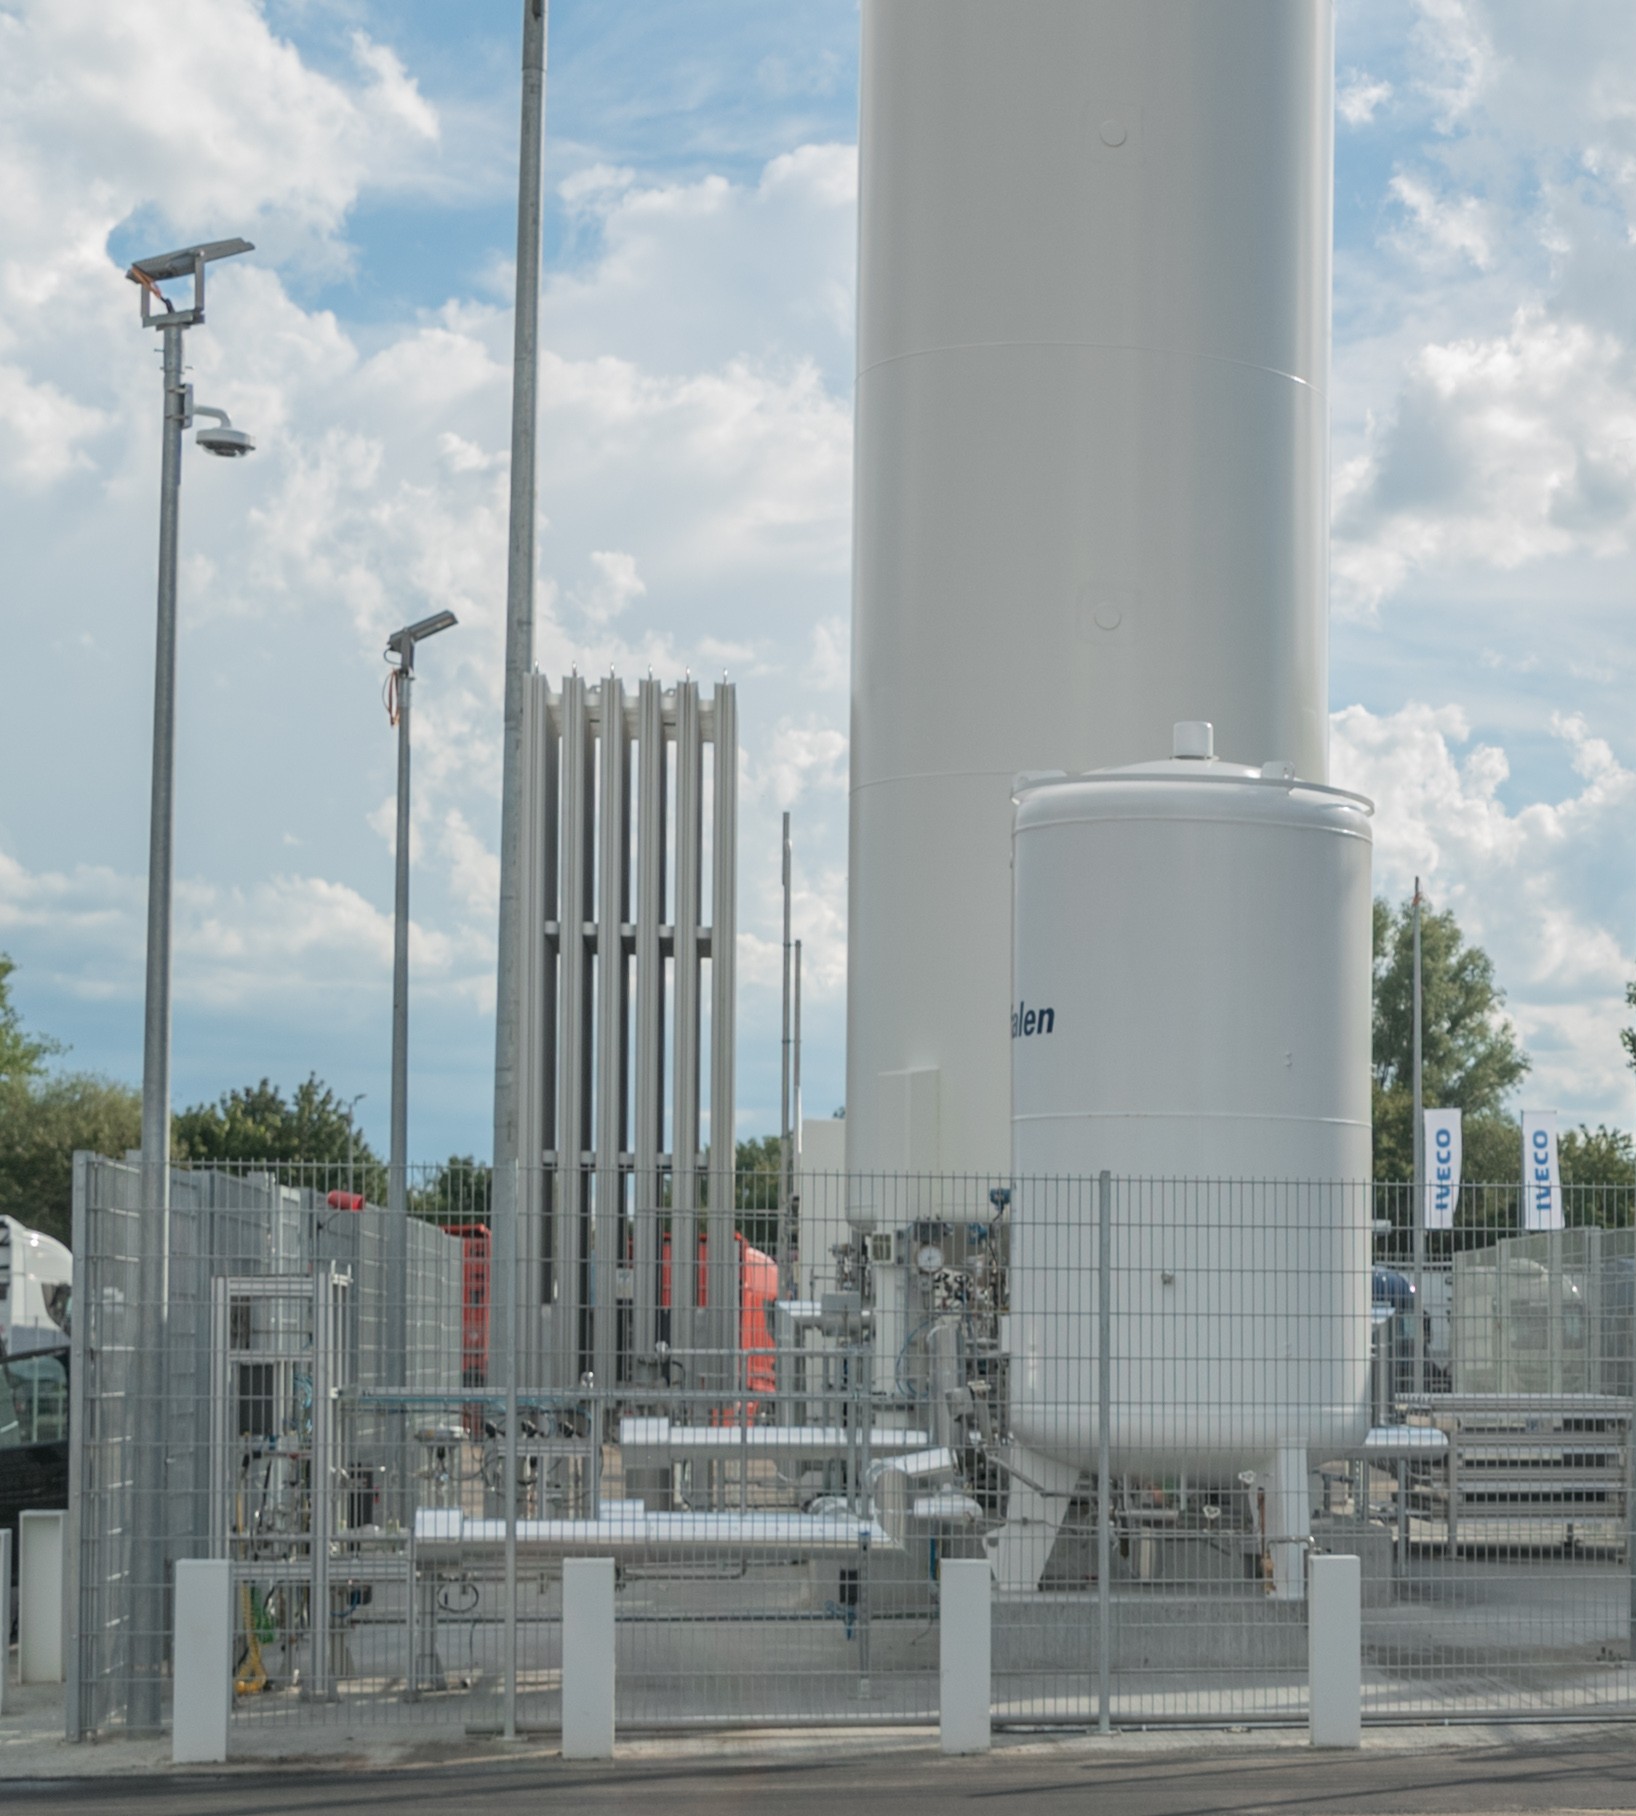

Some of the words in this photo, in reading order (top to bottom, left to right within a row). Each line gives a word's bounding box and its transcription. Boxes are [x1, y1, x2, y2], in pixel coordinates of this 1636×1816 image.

[1010, 1000, 1055, 1038] alen
[1435, 1128, 1451, 1210] IVECO
[1532, 1129, 1551, 1211] IVECO
